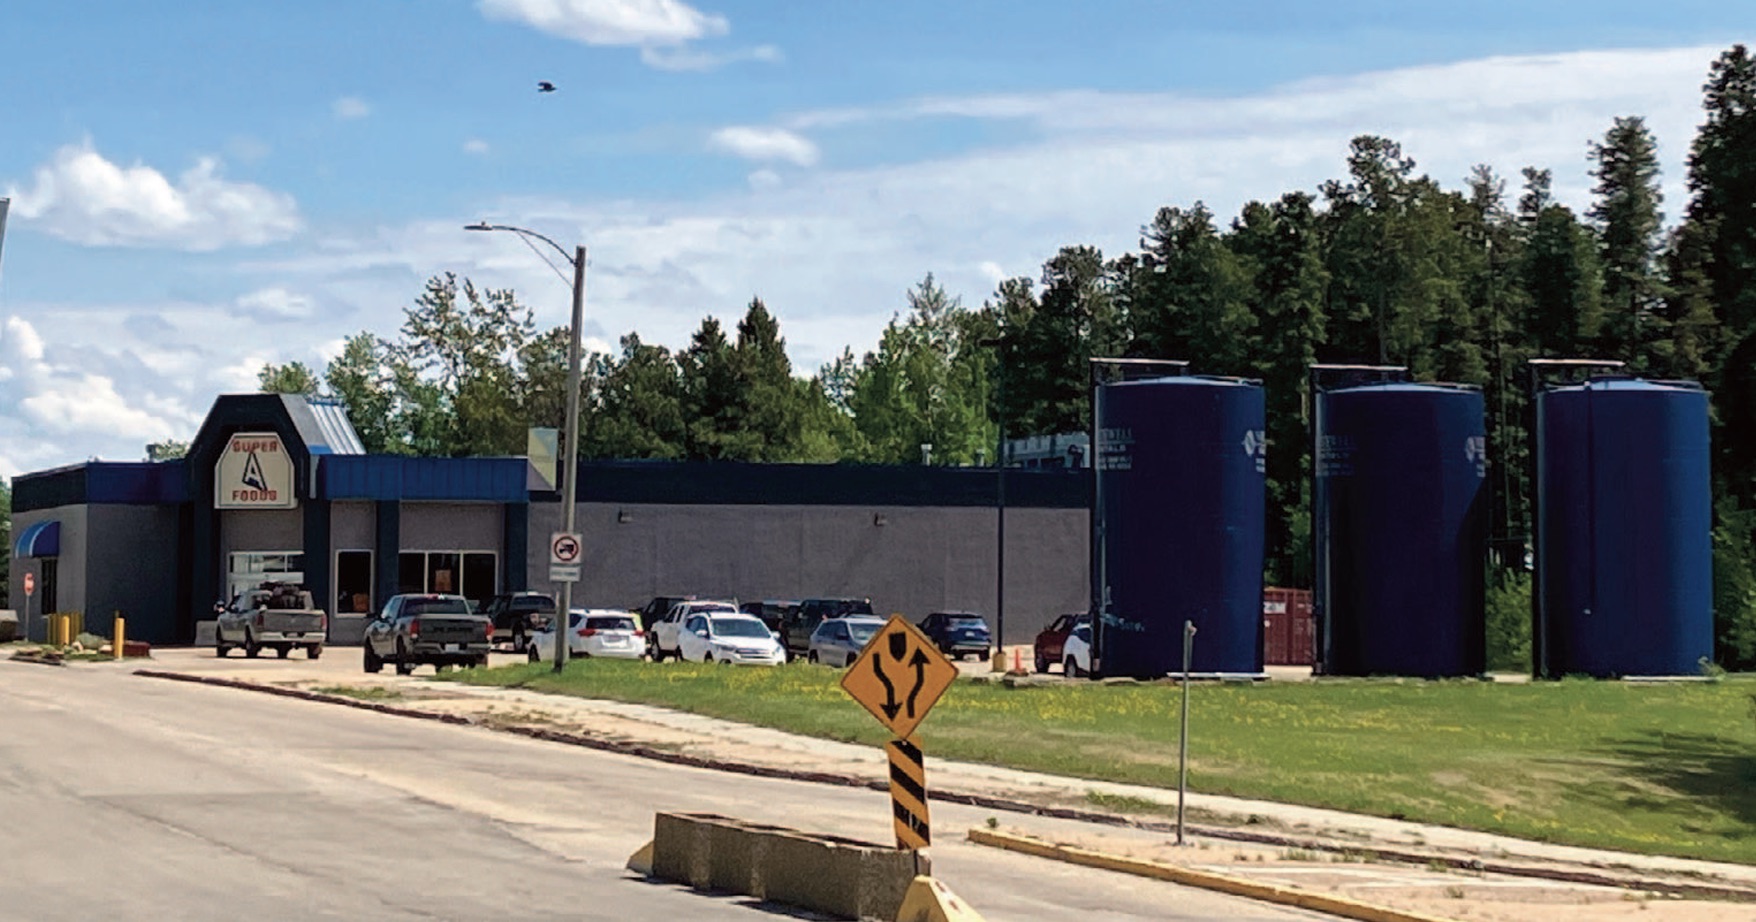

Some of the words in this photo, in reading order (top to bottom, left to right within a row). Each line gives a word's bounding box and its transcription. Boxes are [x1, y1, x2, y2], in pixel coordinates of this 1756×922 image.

[232, 441, 278, 453] SUPER
[242, 450, 268, 491] A
[232, 490, 277, 502] FOODS
